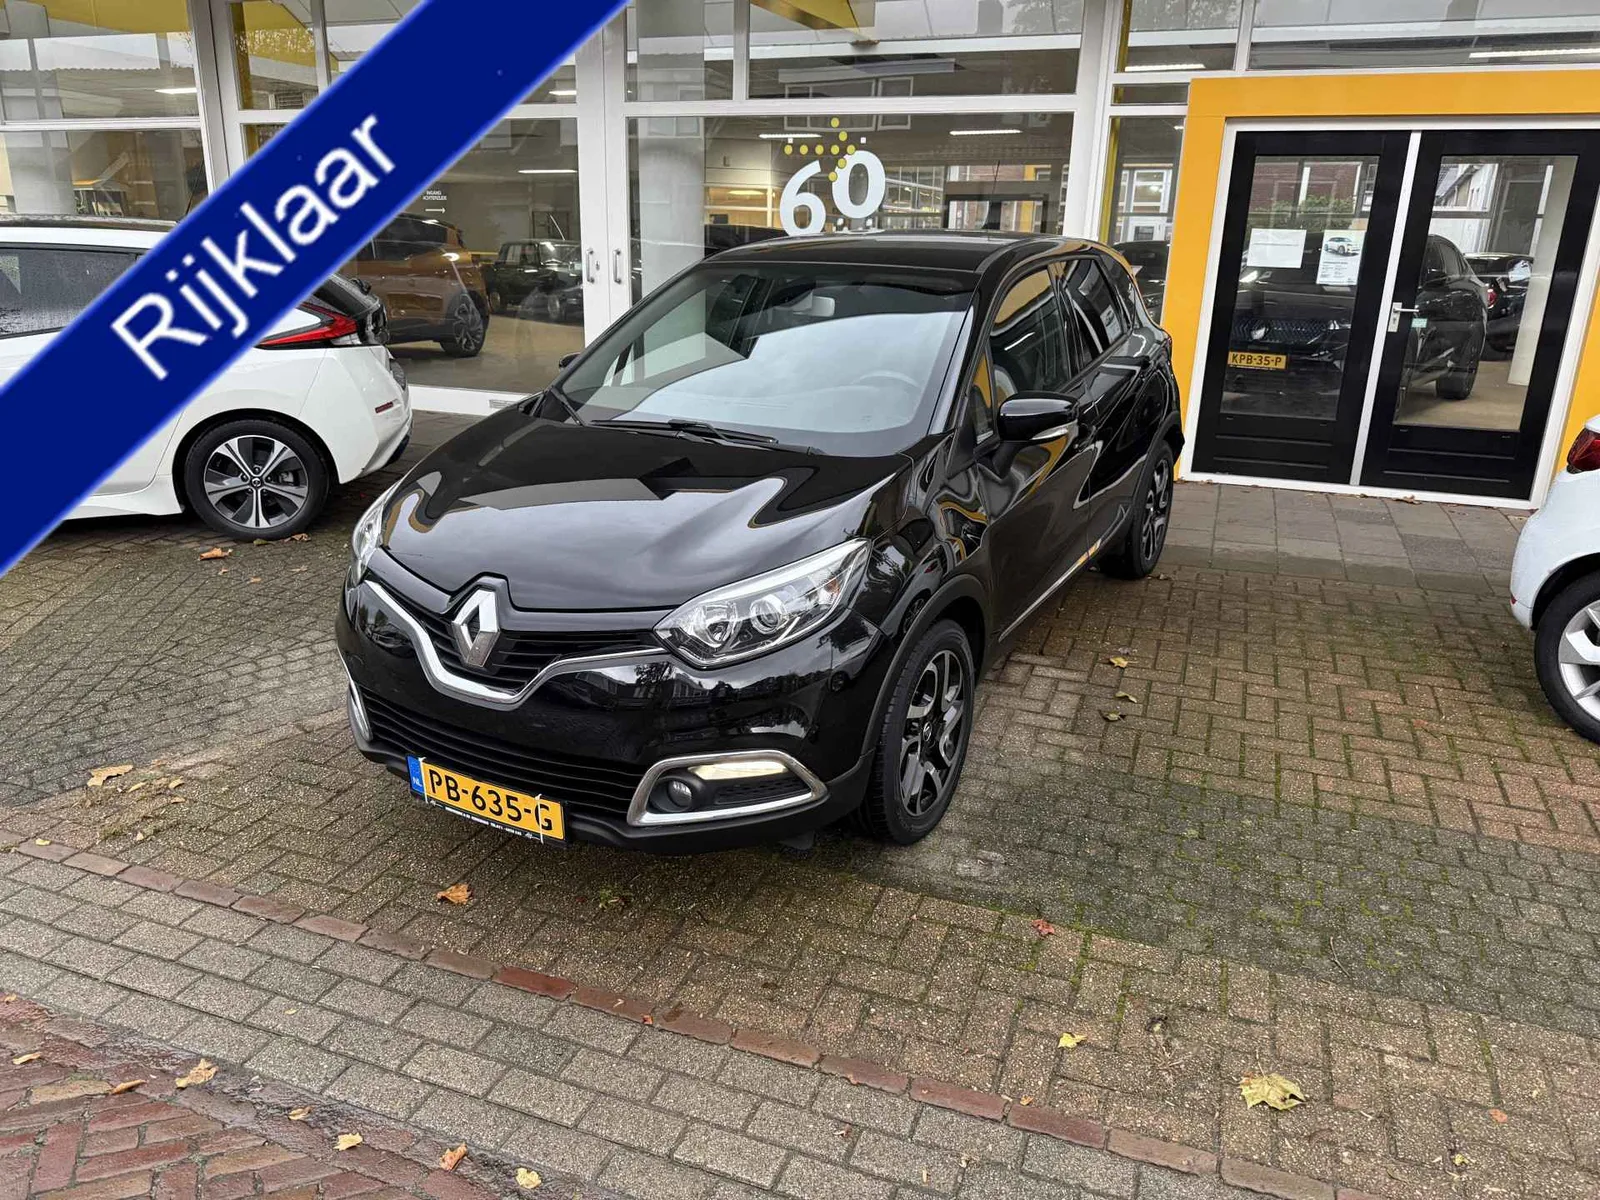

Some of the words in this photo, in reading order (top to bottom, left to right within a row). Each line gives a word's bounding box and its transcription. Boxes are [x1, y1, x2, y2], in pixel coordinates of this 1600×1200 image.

[1231, 353, 1282, 367] KPB-35-P
[412, 777, 423, 787] NL
[428, 769, 553, 831] PB-635-G
